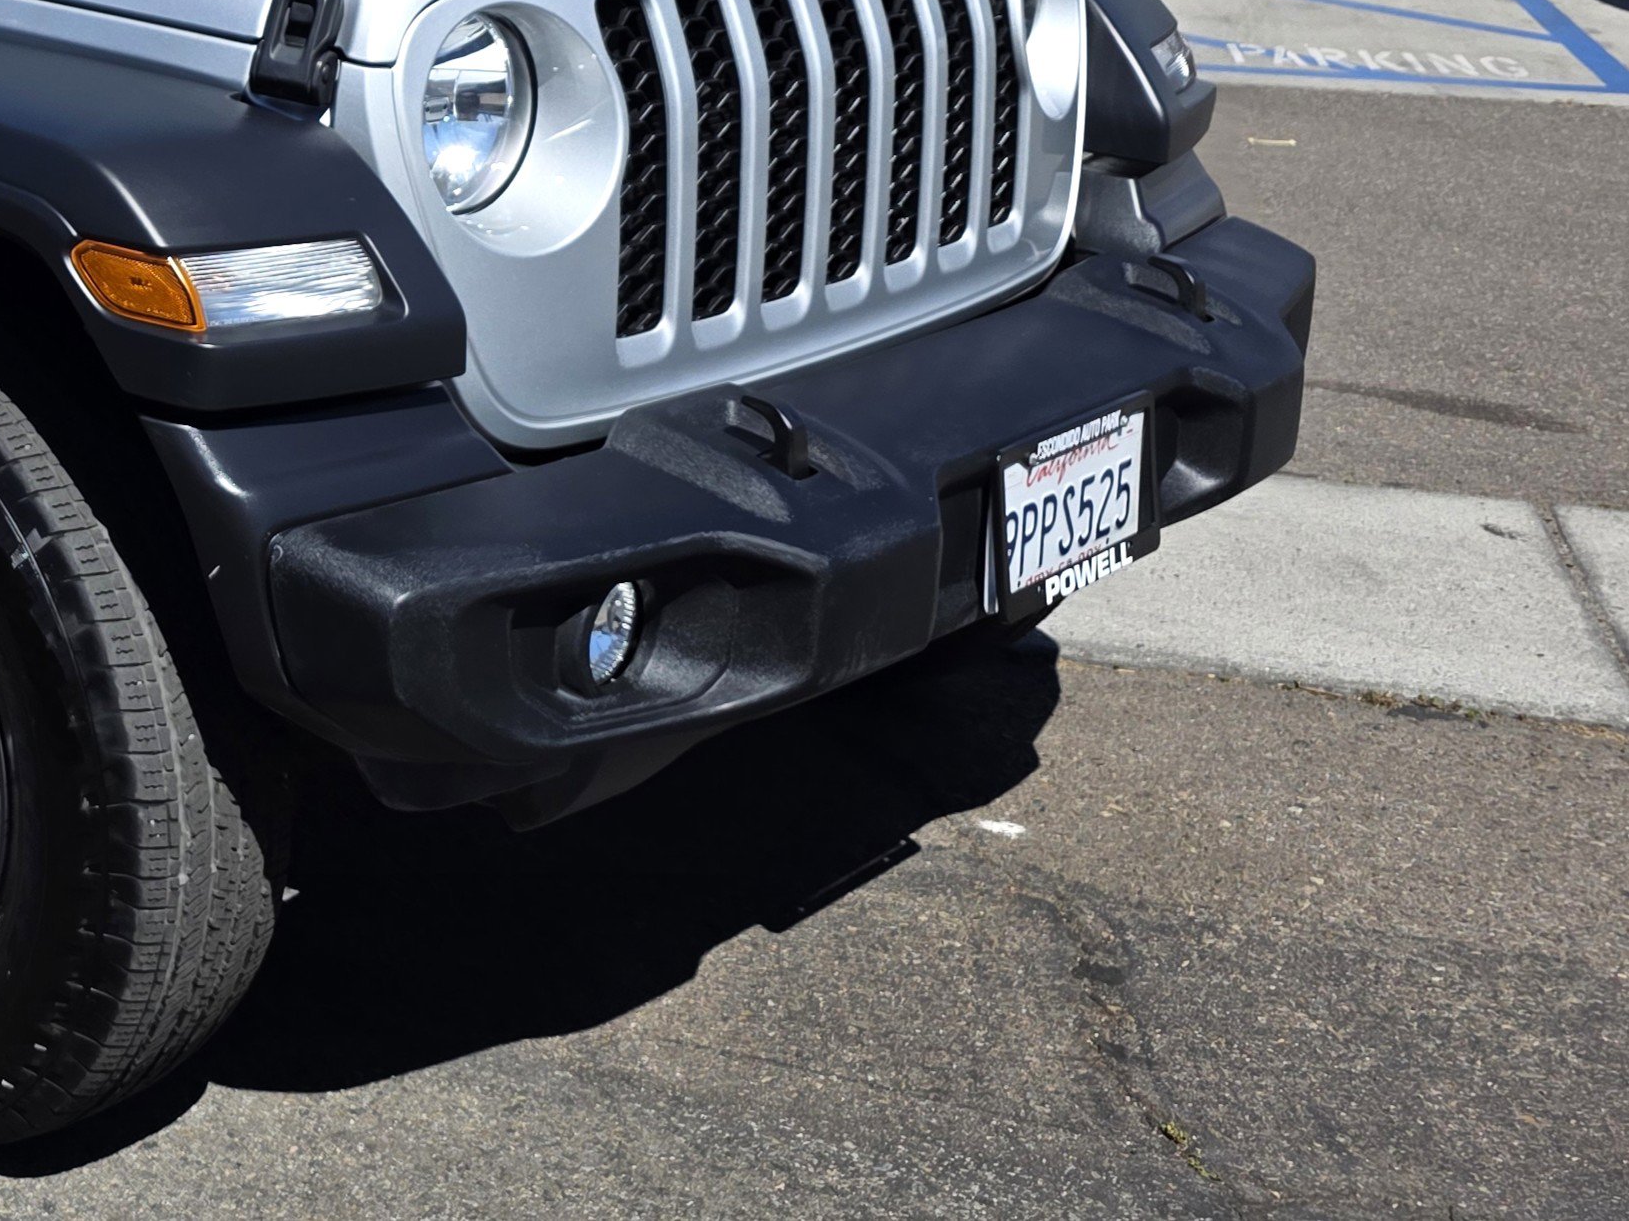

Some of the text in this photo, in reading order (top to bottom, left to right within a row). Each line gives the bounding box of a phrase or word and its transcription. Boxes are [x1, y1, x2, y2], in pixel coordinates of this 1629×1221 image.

[1227, 43, 1529, 78] PARKING
[1080, 417, 1101, 444] AUTO
[1026, 435, 1120, 488] California
[1006, 458, 1132, 578] 9PPS525
[1045, 541, 1134, 606] POWELL
